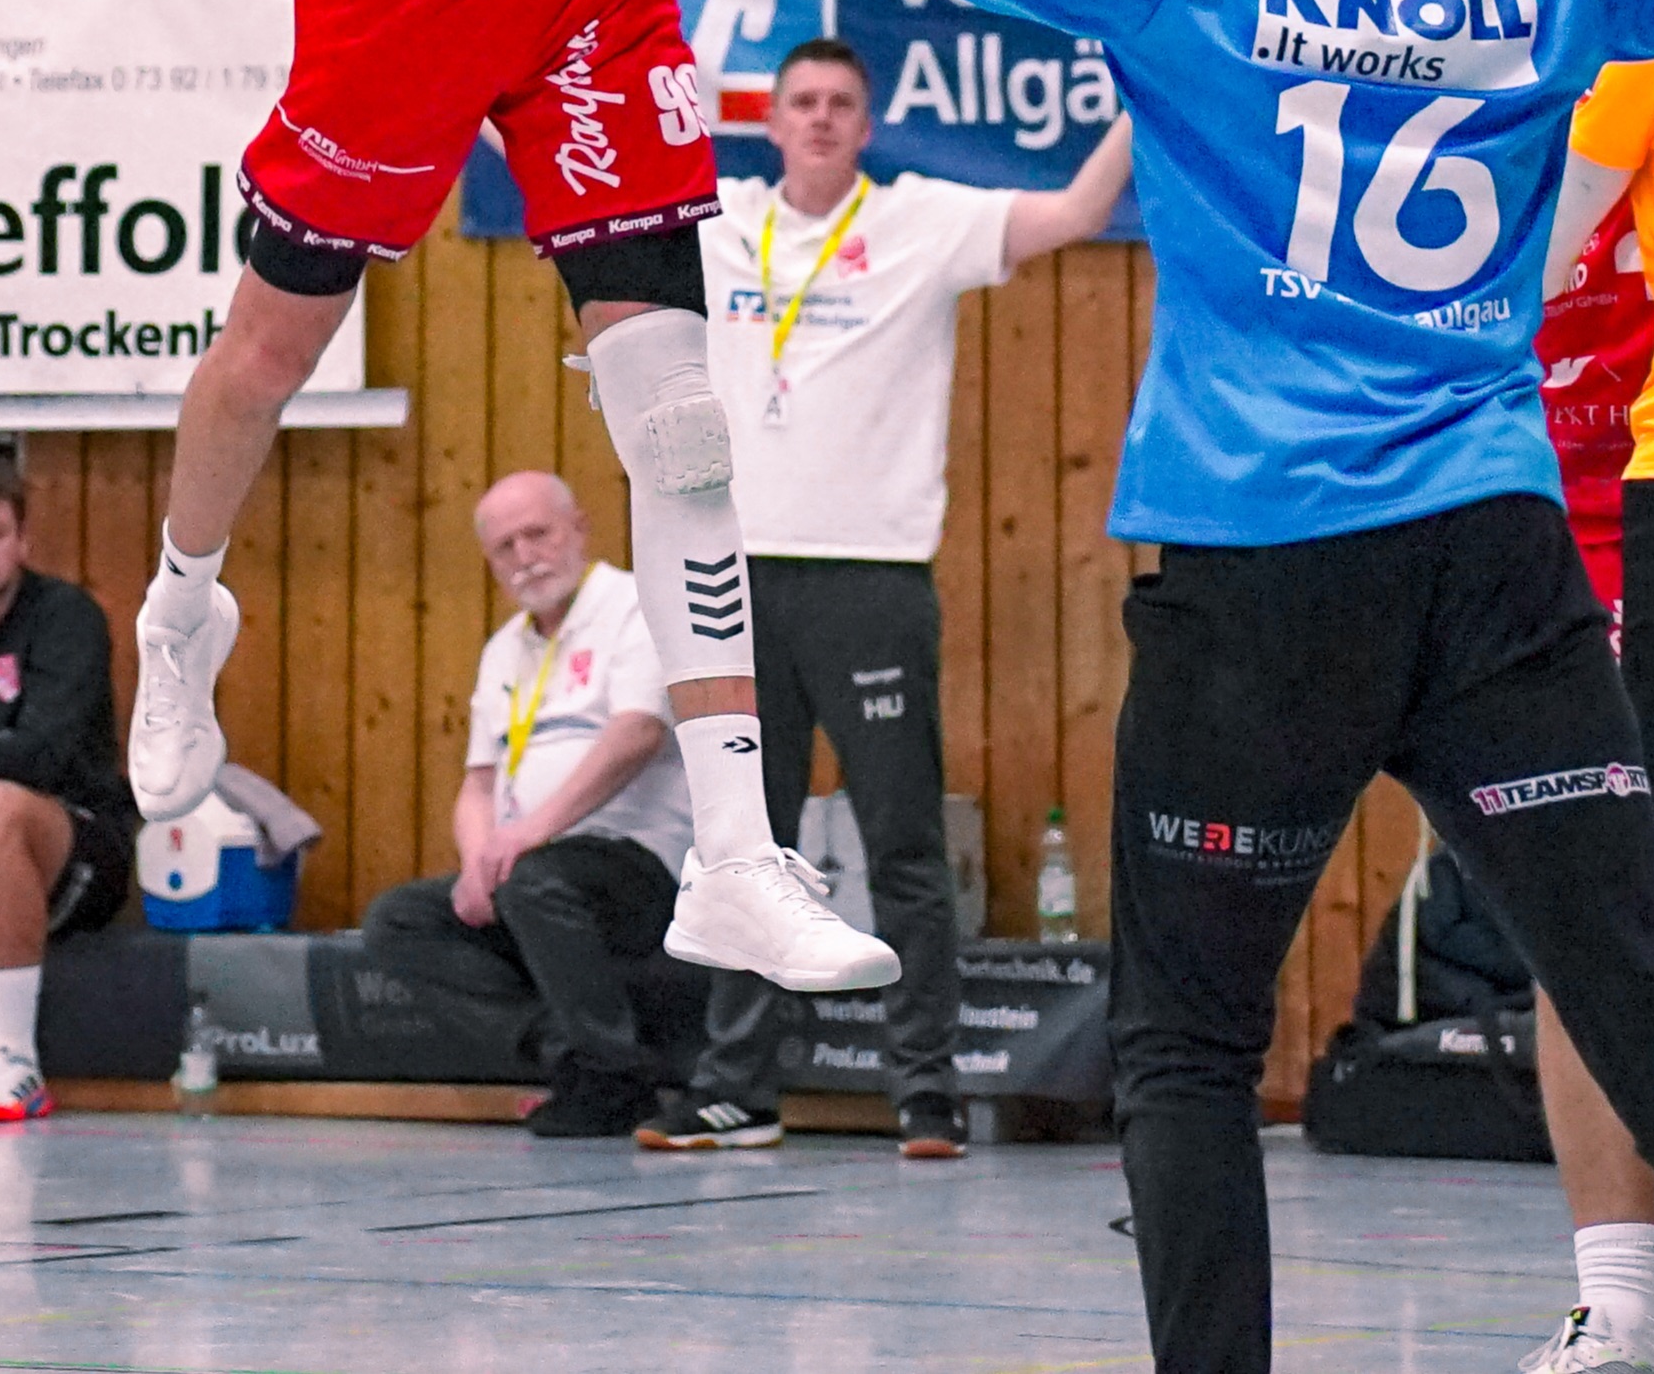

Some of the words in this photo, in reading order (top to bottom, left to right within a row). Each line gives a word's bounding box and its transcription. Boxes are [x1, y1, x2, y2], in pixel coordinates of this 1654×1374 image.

[884, 33, 1119, 151] Allgä
[1322, 44, 1446, 82] works
[1274, 79, 1501, 293] 16
[551, 228, 596, 254] Kempa
[608, 212, 664, 235] Kempa
[676, 198, 723, 220] Kemp
[1259, 267, 1322, 300] TSV
[1412, 297, 1511, 333] aulgau
